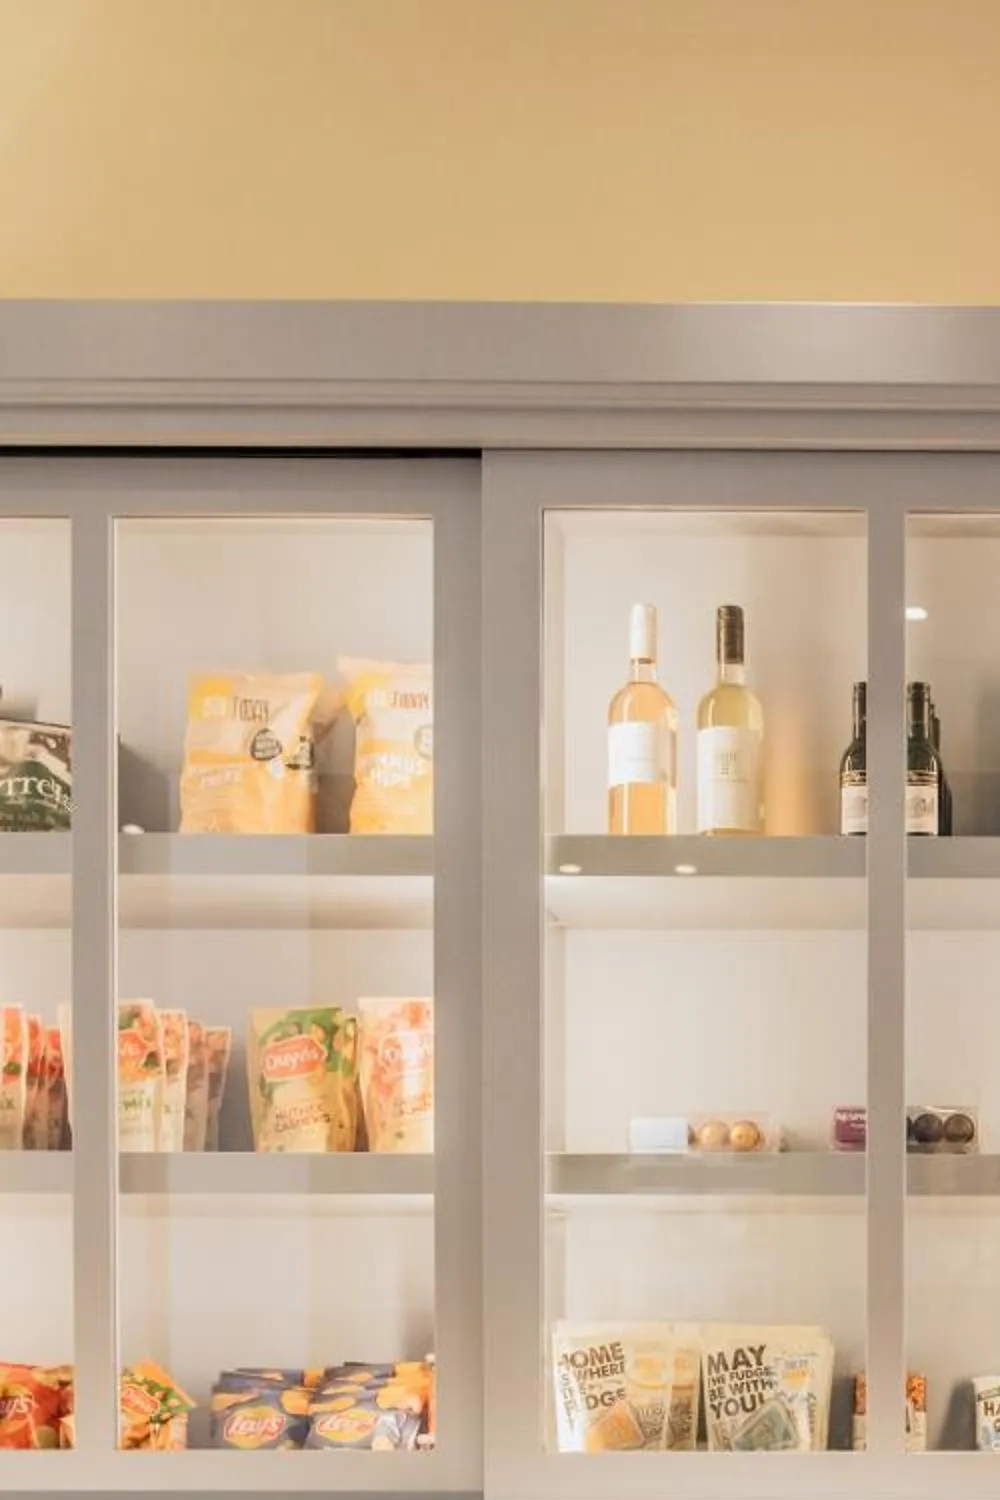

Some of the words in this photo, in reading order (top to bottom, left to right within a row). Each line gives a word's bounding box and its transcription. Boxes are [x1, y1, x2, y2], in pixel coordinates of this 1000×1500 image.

[707, 1344, 766, 1376] MAY
[730, 1366, 775, 1382] FUDGE
[710, 1386, 726, 1402] BE
[729, 1378, 776, 1396] WITH
